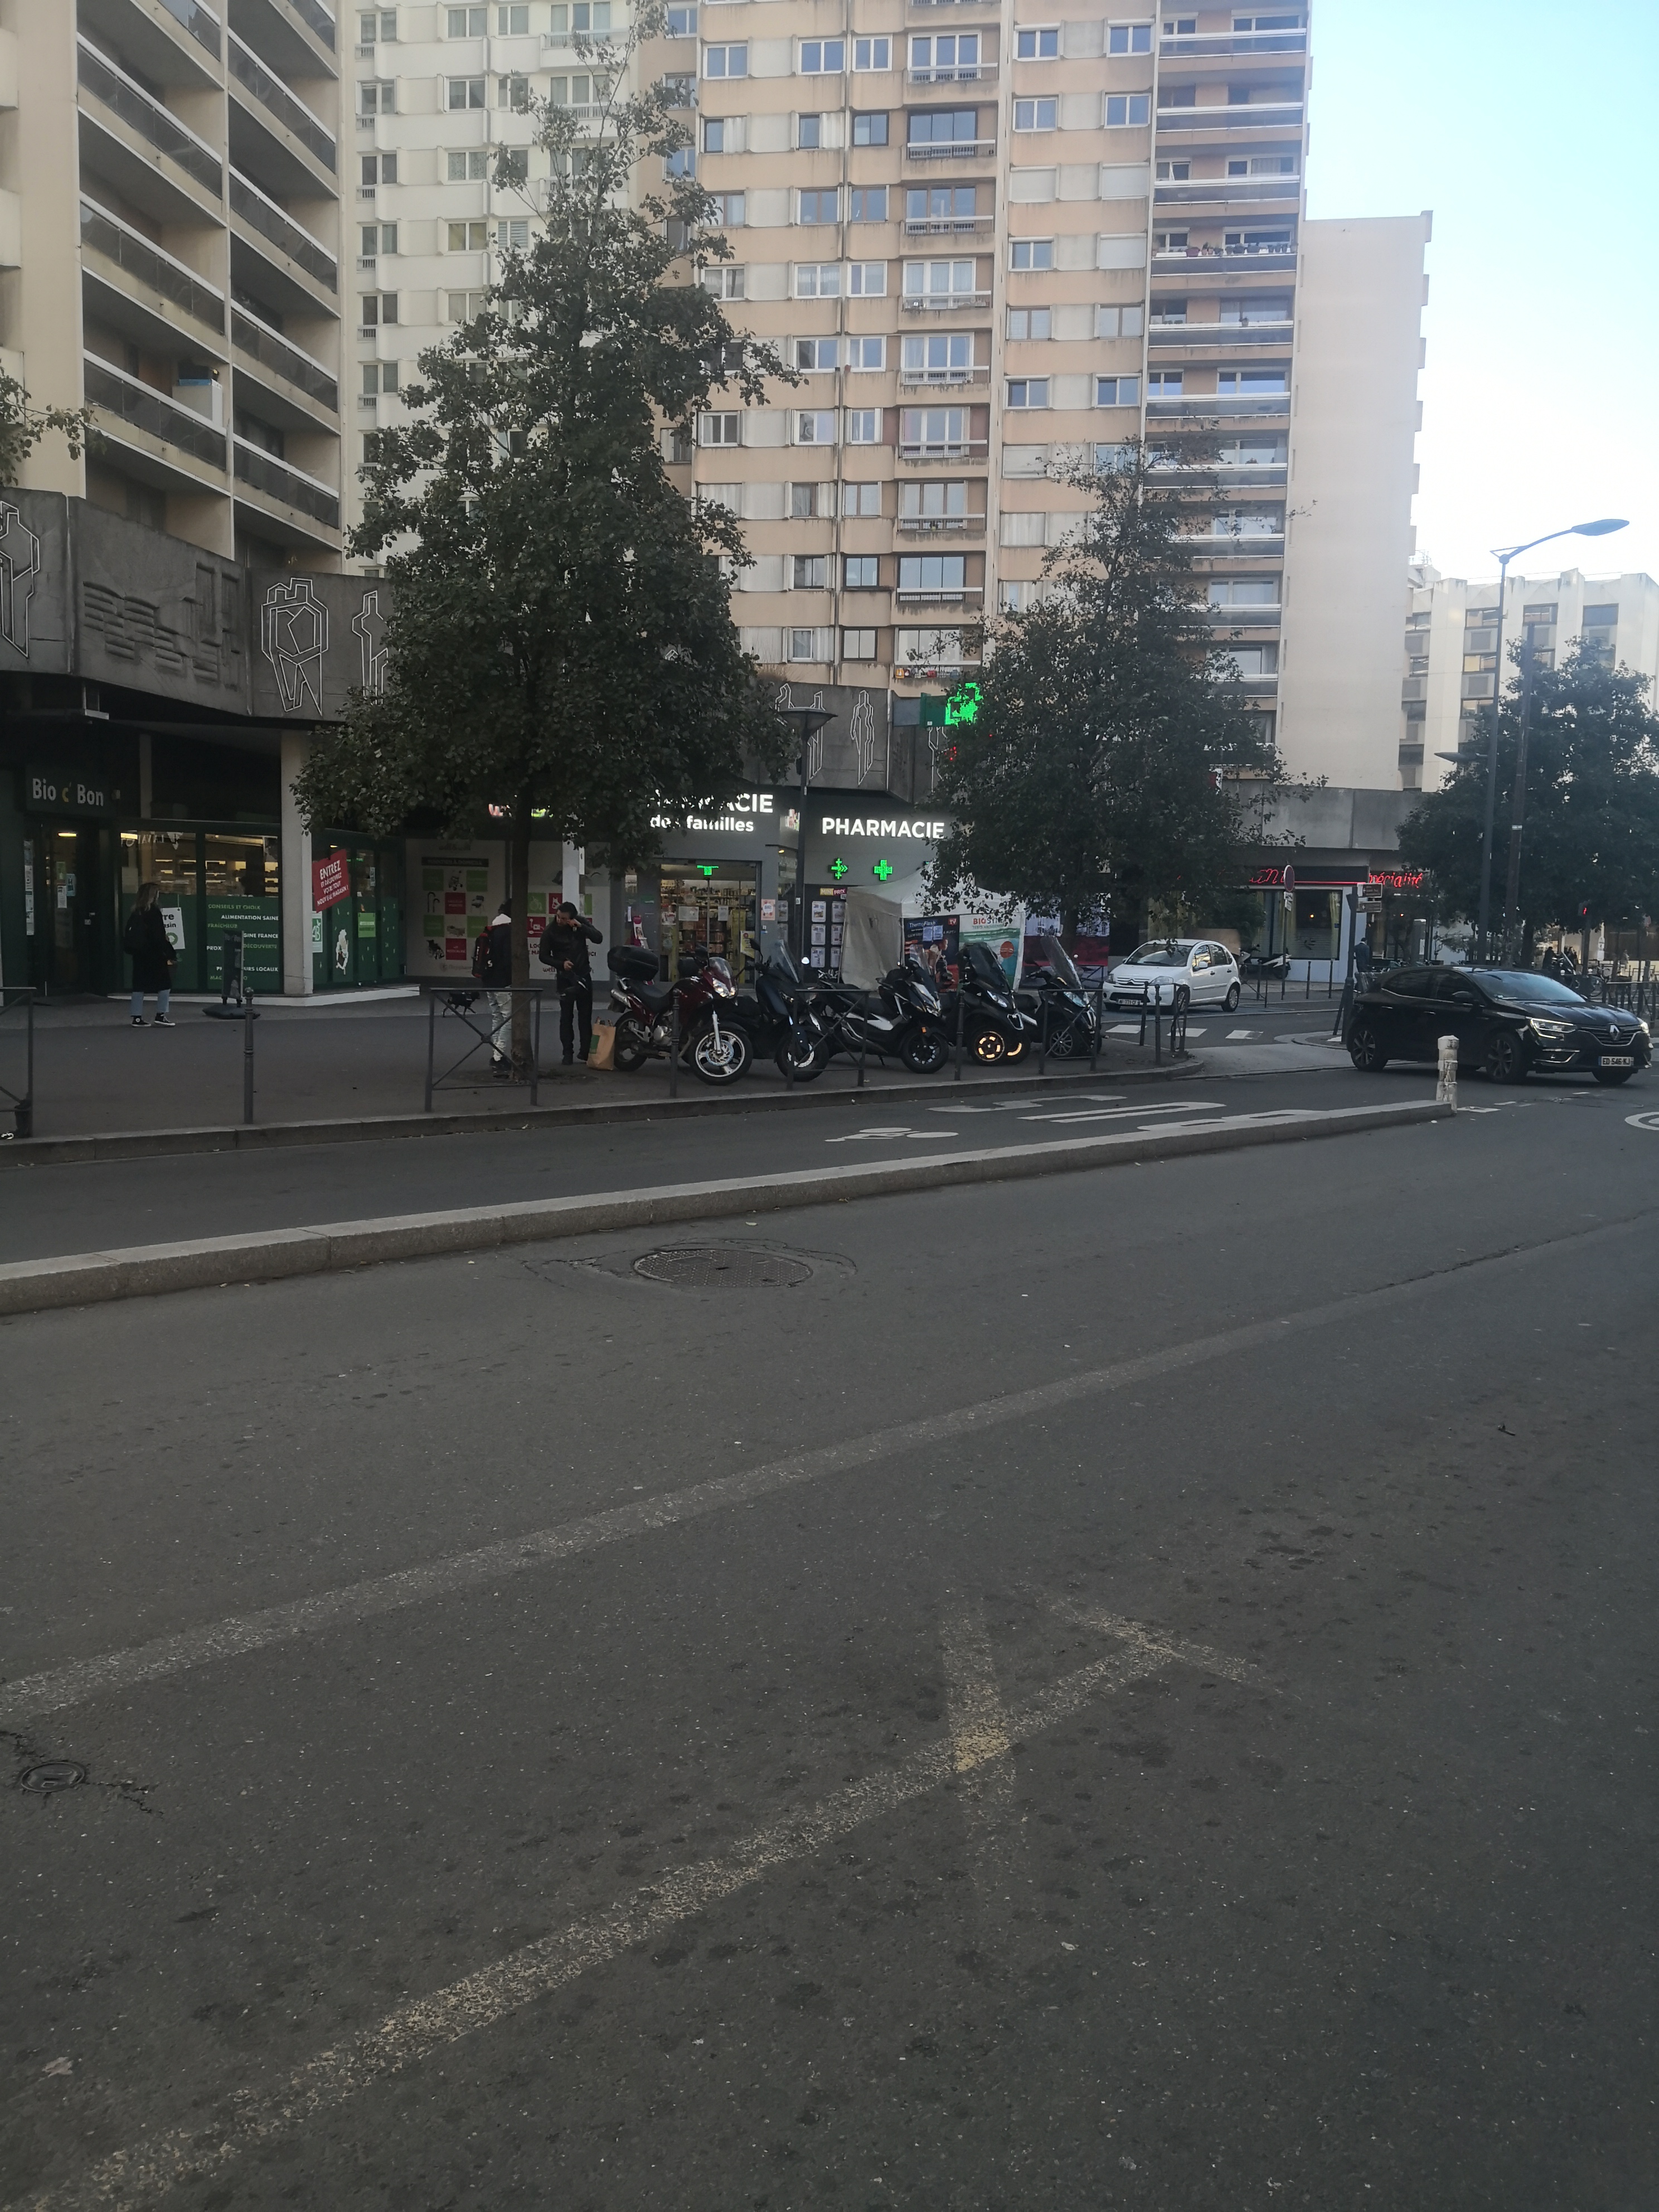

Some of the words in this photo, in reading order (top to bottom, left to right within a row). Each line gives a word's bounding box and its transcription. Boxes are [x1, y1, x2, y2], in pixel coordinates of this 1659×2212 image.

[32, 778, 56, 801] Bio
[77, 784, 104, 806] Bon
[686, 815, 754, 832] familles
[822, 817, 945, 839] PHARMACIE
[319, 860, 341, 880] ENTREZ
